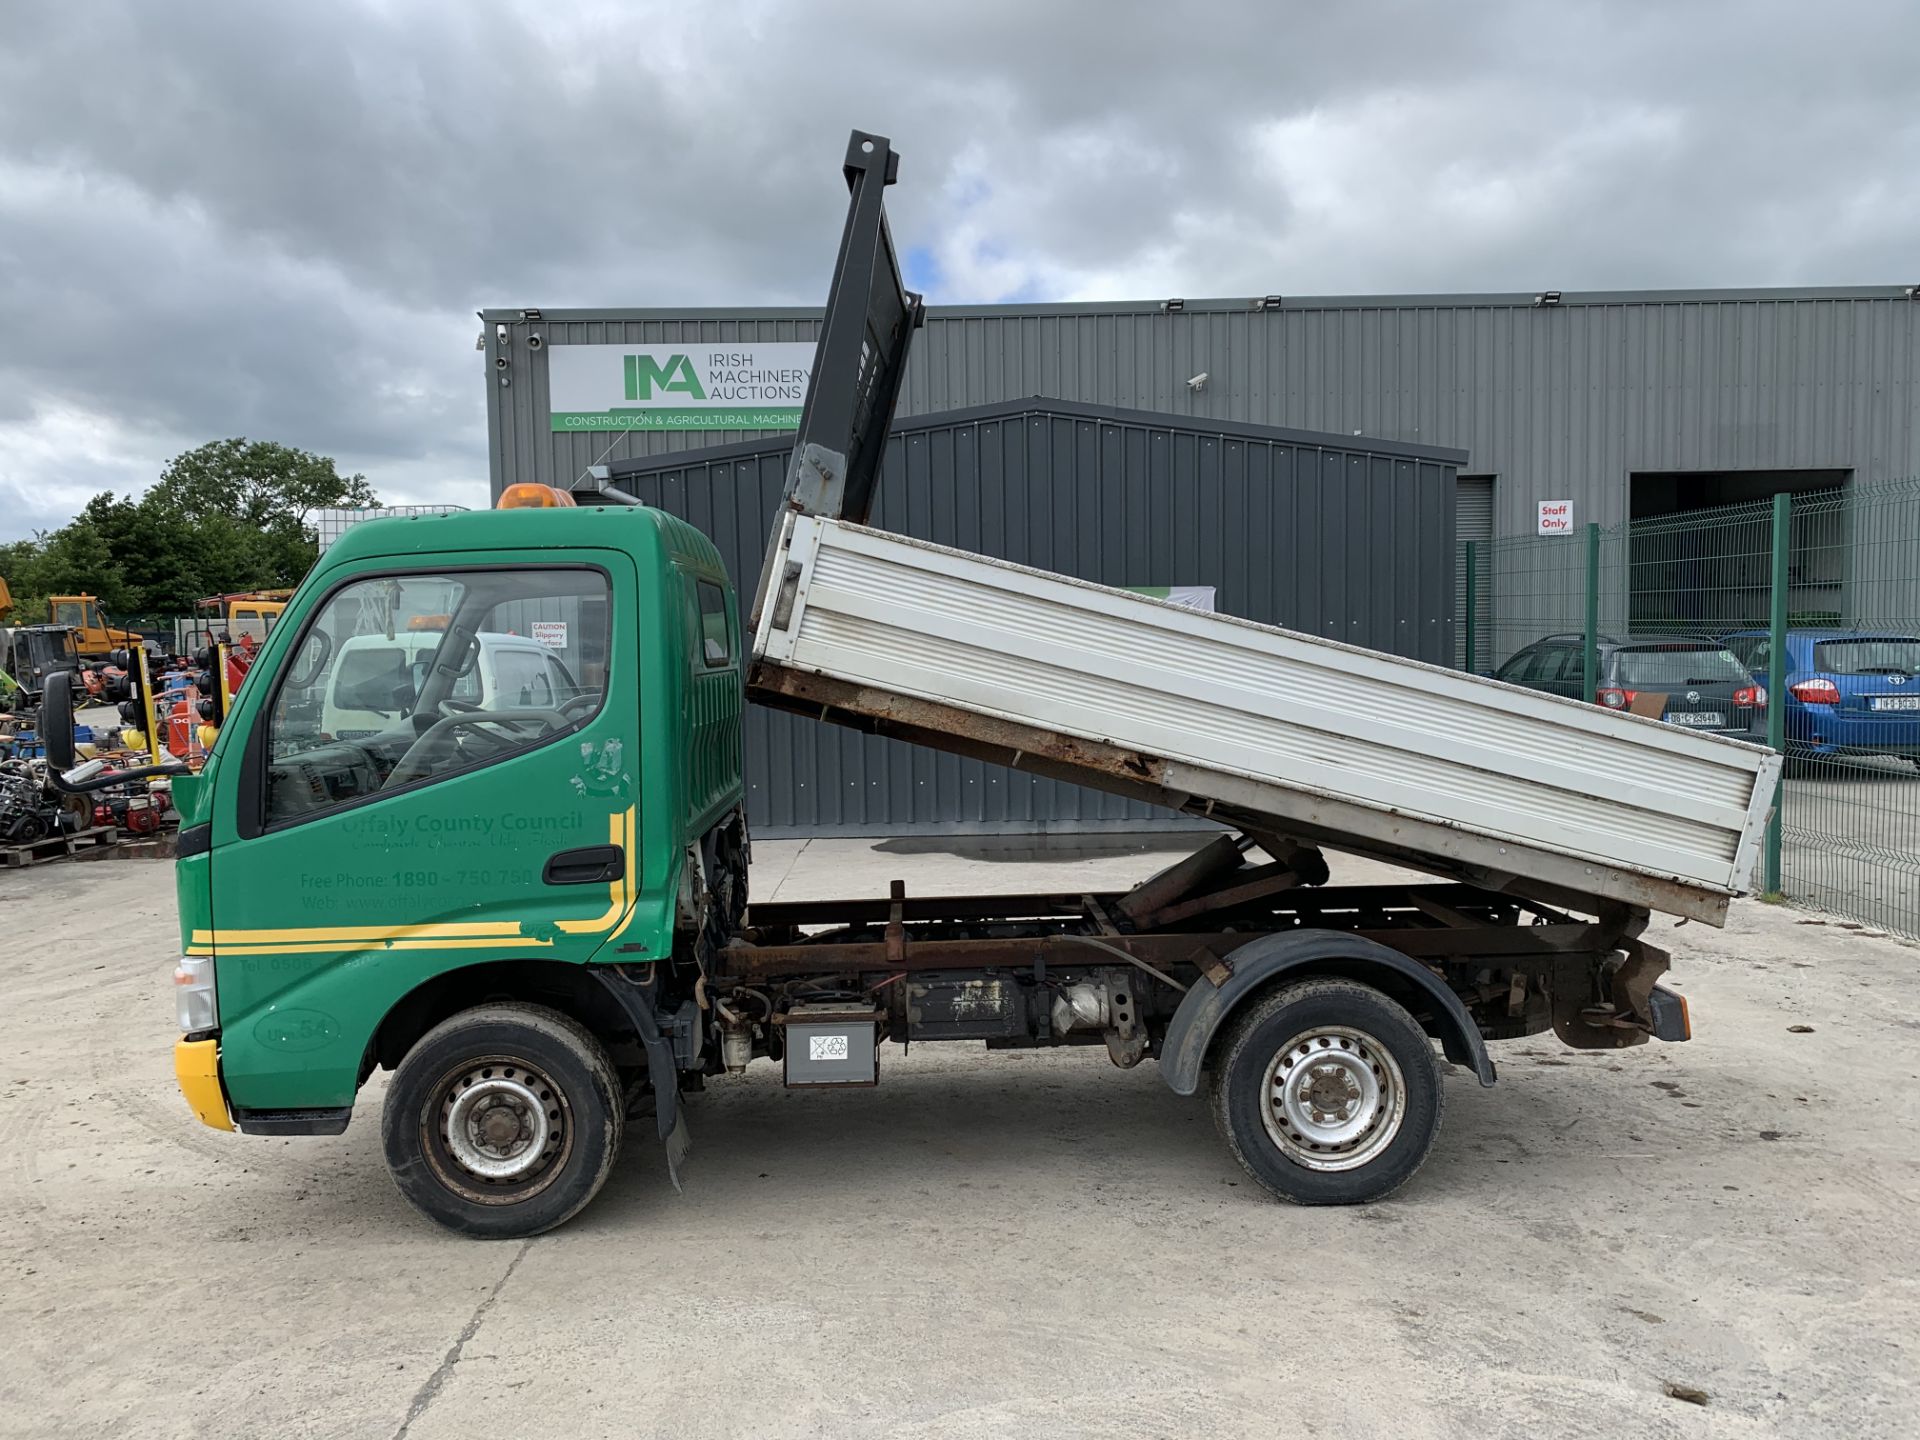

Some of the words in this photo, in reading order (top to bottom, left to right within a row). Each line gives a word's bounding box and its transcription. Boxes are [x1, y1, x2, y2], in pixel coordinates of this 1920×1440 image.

[709, 353, 753, 367] IRISH
[624, 354, 707, 401] IMA
[709, 369, 811, 384] MACHINERY
[710, 386, 802, 400] AUCTIONS
[565, 415, 652, 427] CONSTRUCTION
[655, 415, 664, 425] &
[666, 414, 750, 425] AGRICULTURAL
[1542, 505, 1567, 515] Staff
[1542, 518, 1568, 530] Only
[535, 631, 564, 639] Slippery
[414, 814, 494, 836] County
[501, 811, 583, 832] Council
[301, 873, 332, 888] Free
[337, 872, 388, 888] Phone:
[392, 871, 438, 887] 1890
[456, 869, 491, 886] 750
